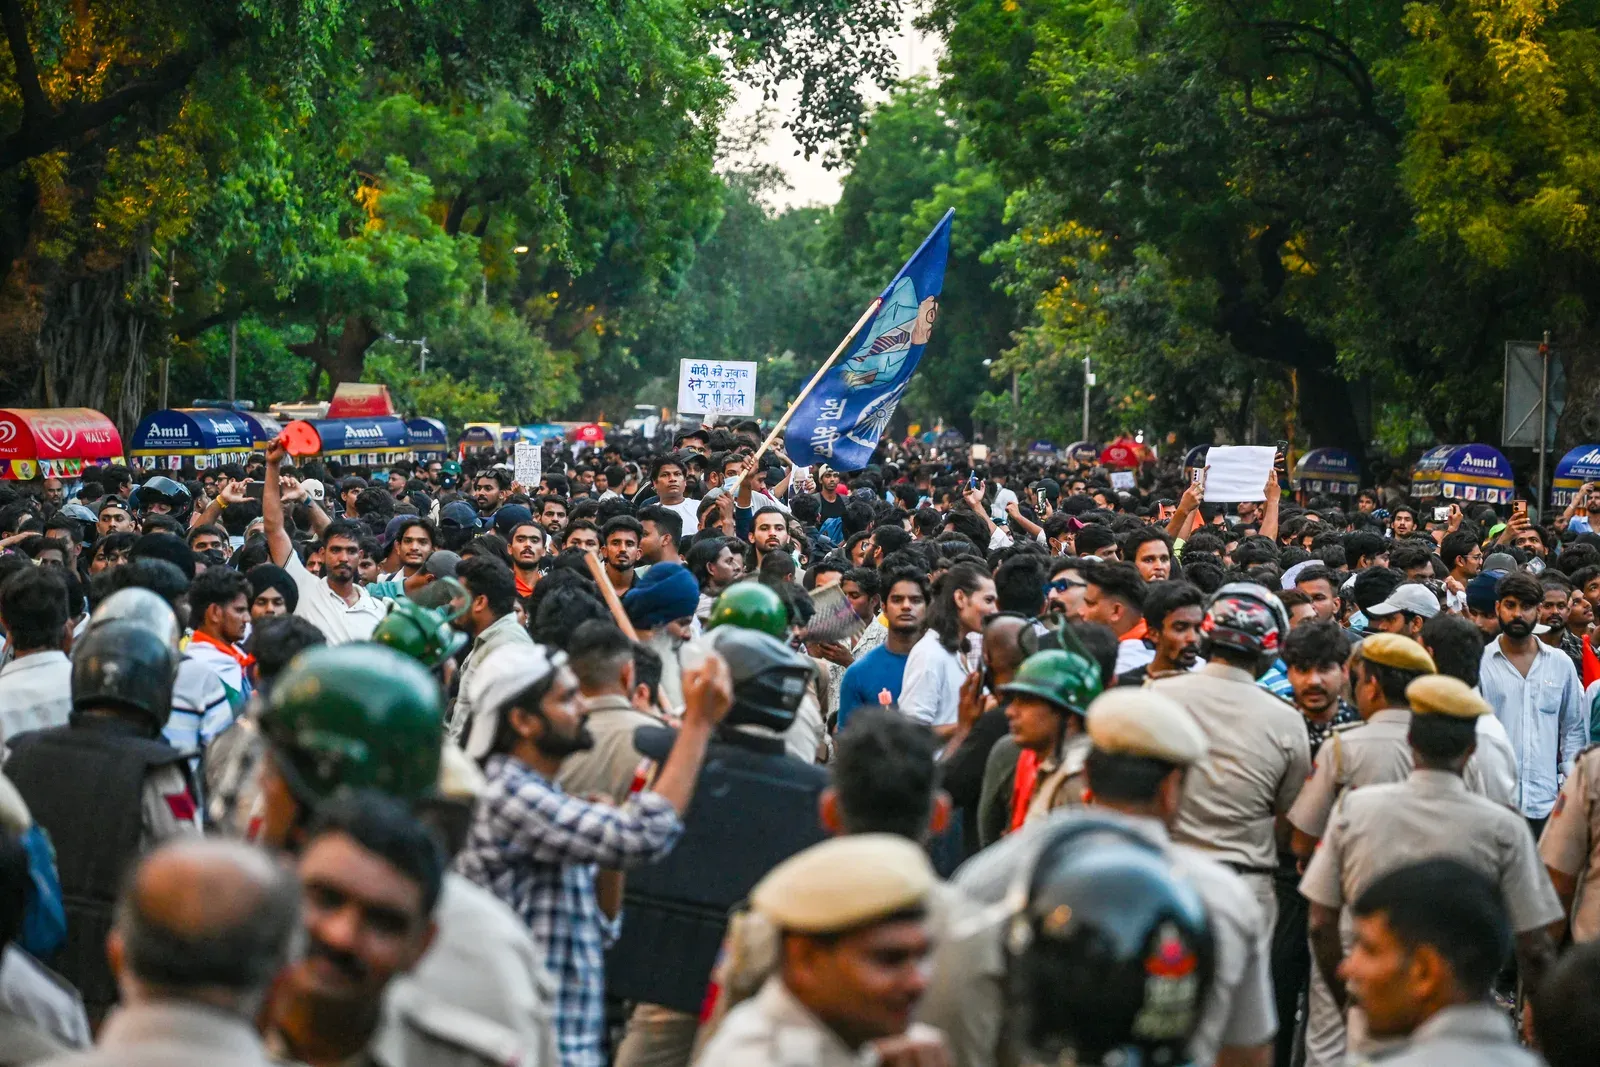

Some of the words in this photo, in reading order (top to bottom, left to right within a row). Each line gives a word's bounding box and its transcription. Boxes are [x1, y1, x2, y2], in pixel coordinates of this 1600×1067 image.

[690, 363, 709, 378] मोदी
[688, 377, 704, 391] देने
[706, 380, 718, 389] आ
[816, 398, 848, 421] जय
[83, 431, 111, 443] WALL'S
[147, 422, 189, 438] Amul
[345, 424, 384, 438] Amul
[810, 426, 841, 458] भीम
[1318, 454, 1347, 467] Amul
[1461, 452, 1497, 469] Amul
[1577, 448, 1600, 465] Am
